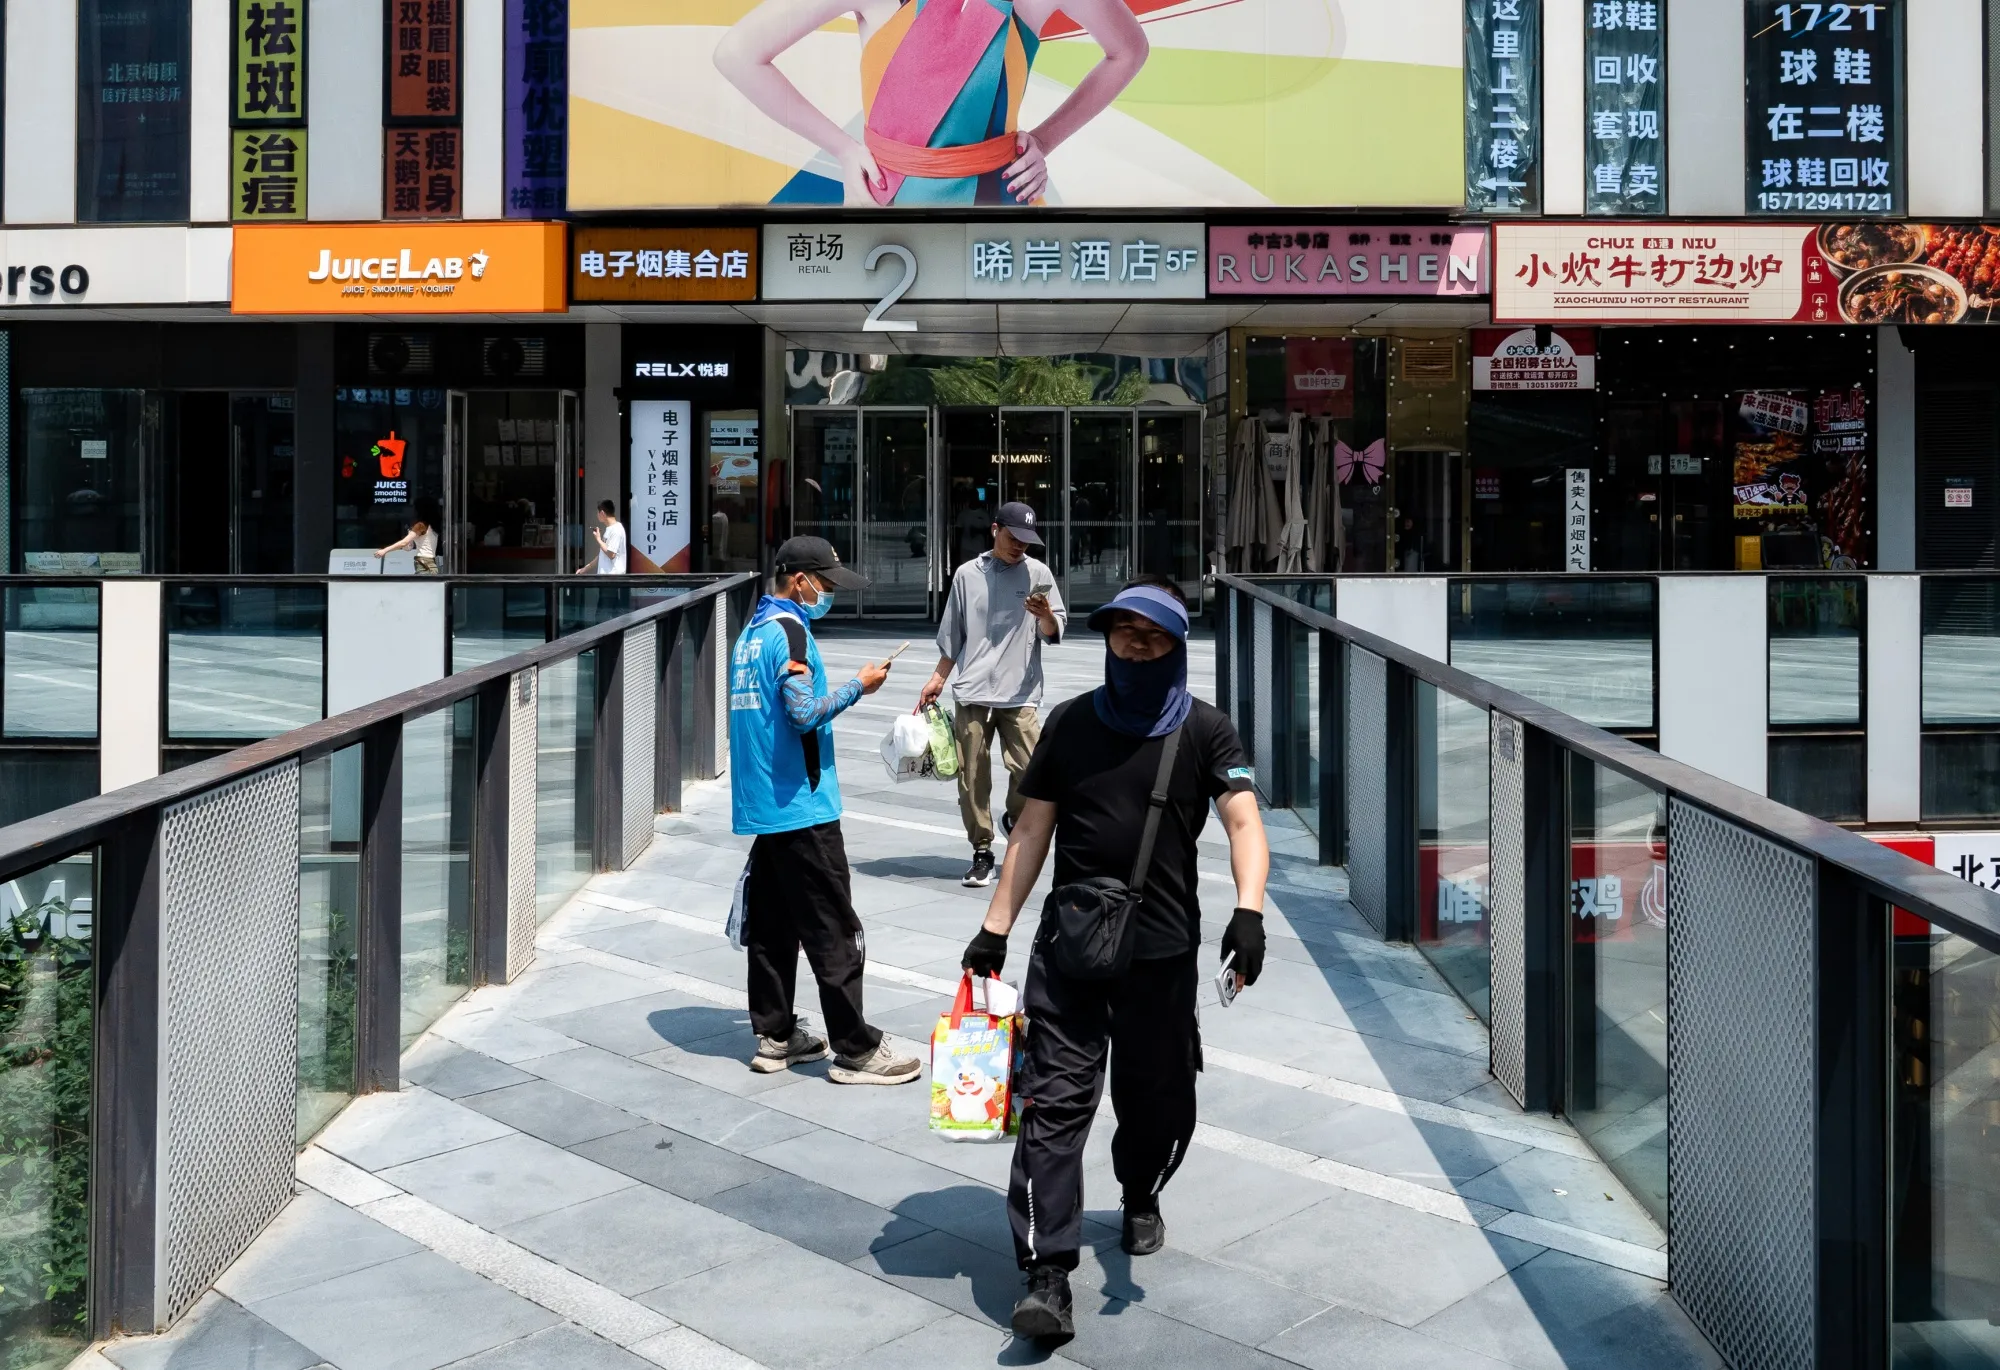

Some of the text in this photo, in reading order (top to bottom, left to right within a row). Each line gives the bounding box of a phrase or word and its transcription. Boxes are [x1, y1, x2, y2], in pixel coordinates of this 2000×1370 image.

[1593, 1, 1657, 31] 球鞋
[1775, 4, 1875, 31] 1721
[399, 1, 422, 77] 双眼皮
[245, 2, 296, 114] 祛斑
[1594, 54, 1657, 84] 回收
[102, 86, 182, 103] 医疗美容诊所
[427, 59, 451, 111] 眼袋
[522, 0, 564, 178] 轮廓优塑
[1490, 0, 1520, 168] 这里上二楼
[1593, 110, 1658, 139] 套现
[1767, 103, 1885, 143] 在二楼
[242, 134, 298, 215] 治痘
[394, 132, 420, 212] 天鹅颈
[425, 131, 456, 213] 瘦身
[1593, 163, 1658, 196] 售卖
[1762, 157, 1889, 187] 球鞋回收
[1757, 192, 1891, 210] 15712941721
[787, 232, 843, 261] 商场
[1587, 238, 1635, 249] CHUI
[1682, 238, 1716, 249] NIU
[580, 249, 749, 278] 电子烟集合店
[798, 265, 831, 274] RETAIL
[973, 239, 1198, 282] 晞岸酒店 5F
[1217, 254, 1478, 282] RUKASHEN
[1515, 252, 1783, 289] 小炊牛打边炉
[341, 285, 455, 293] JUICE SMOOTHIE YOGURT
[862, 244, 918, 332] 2
[636, 363, 728, 377] RELX 悦刻
[1490, 357, 1577, 369] 全国招募合伙人
[661, 410, 679, 526] 电子烟集合店
[374, 481, 407, 489] JUICES
[646, 449, 657, 554] VAPE SHOP
[1570, 471, 1586, 570] 售卖人间烟火气
[1572, 874, 1623, 920] 鸡
